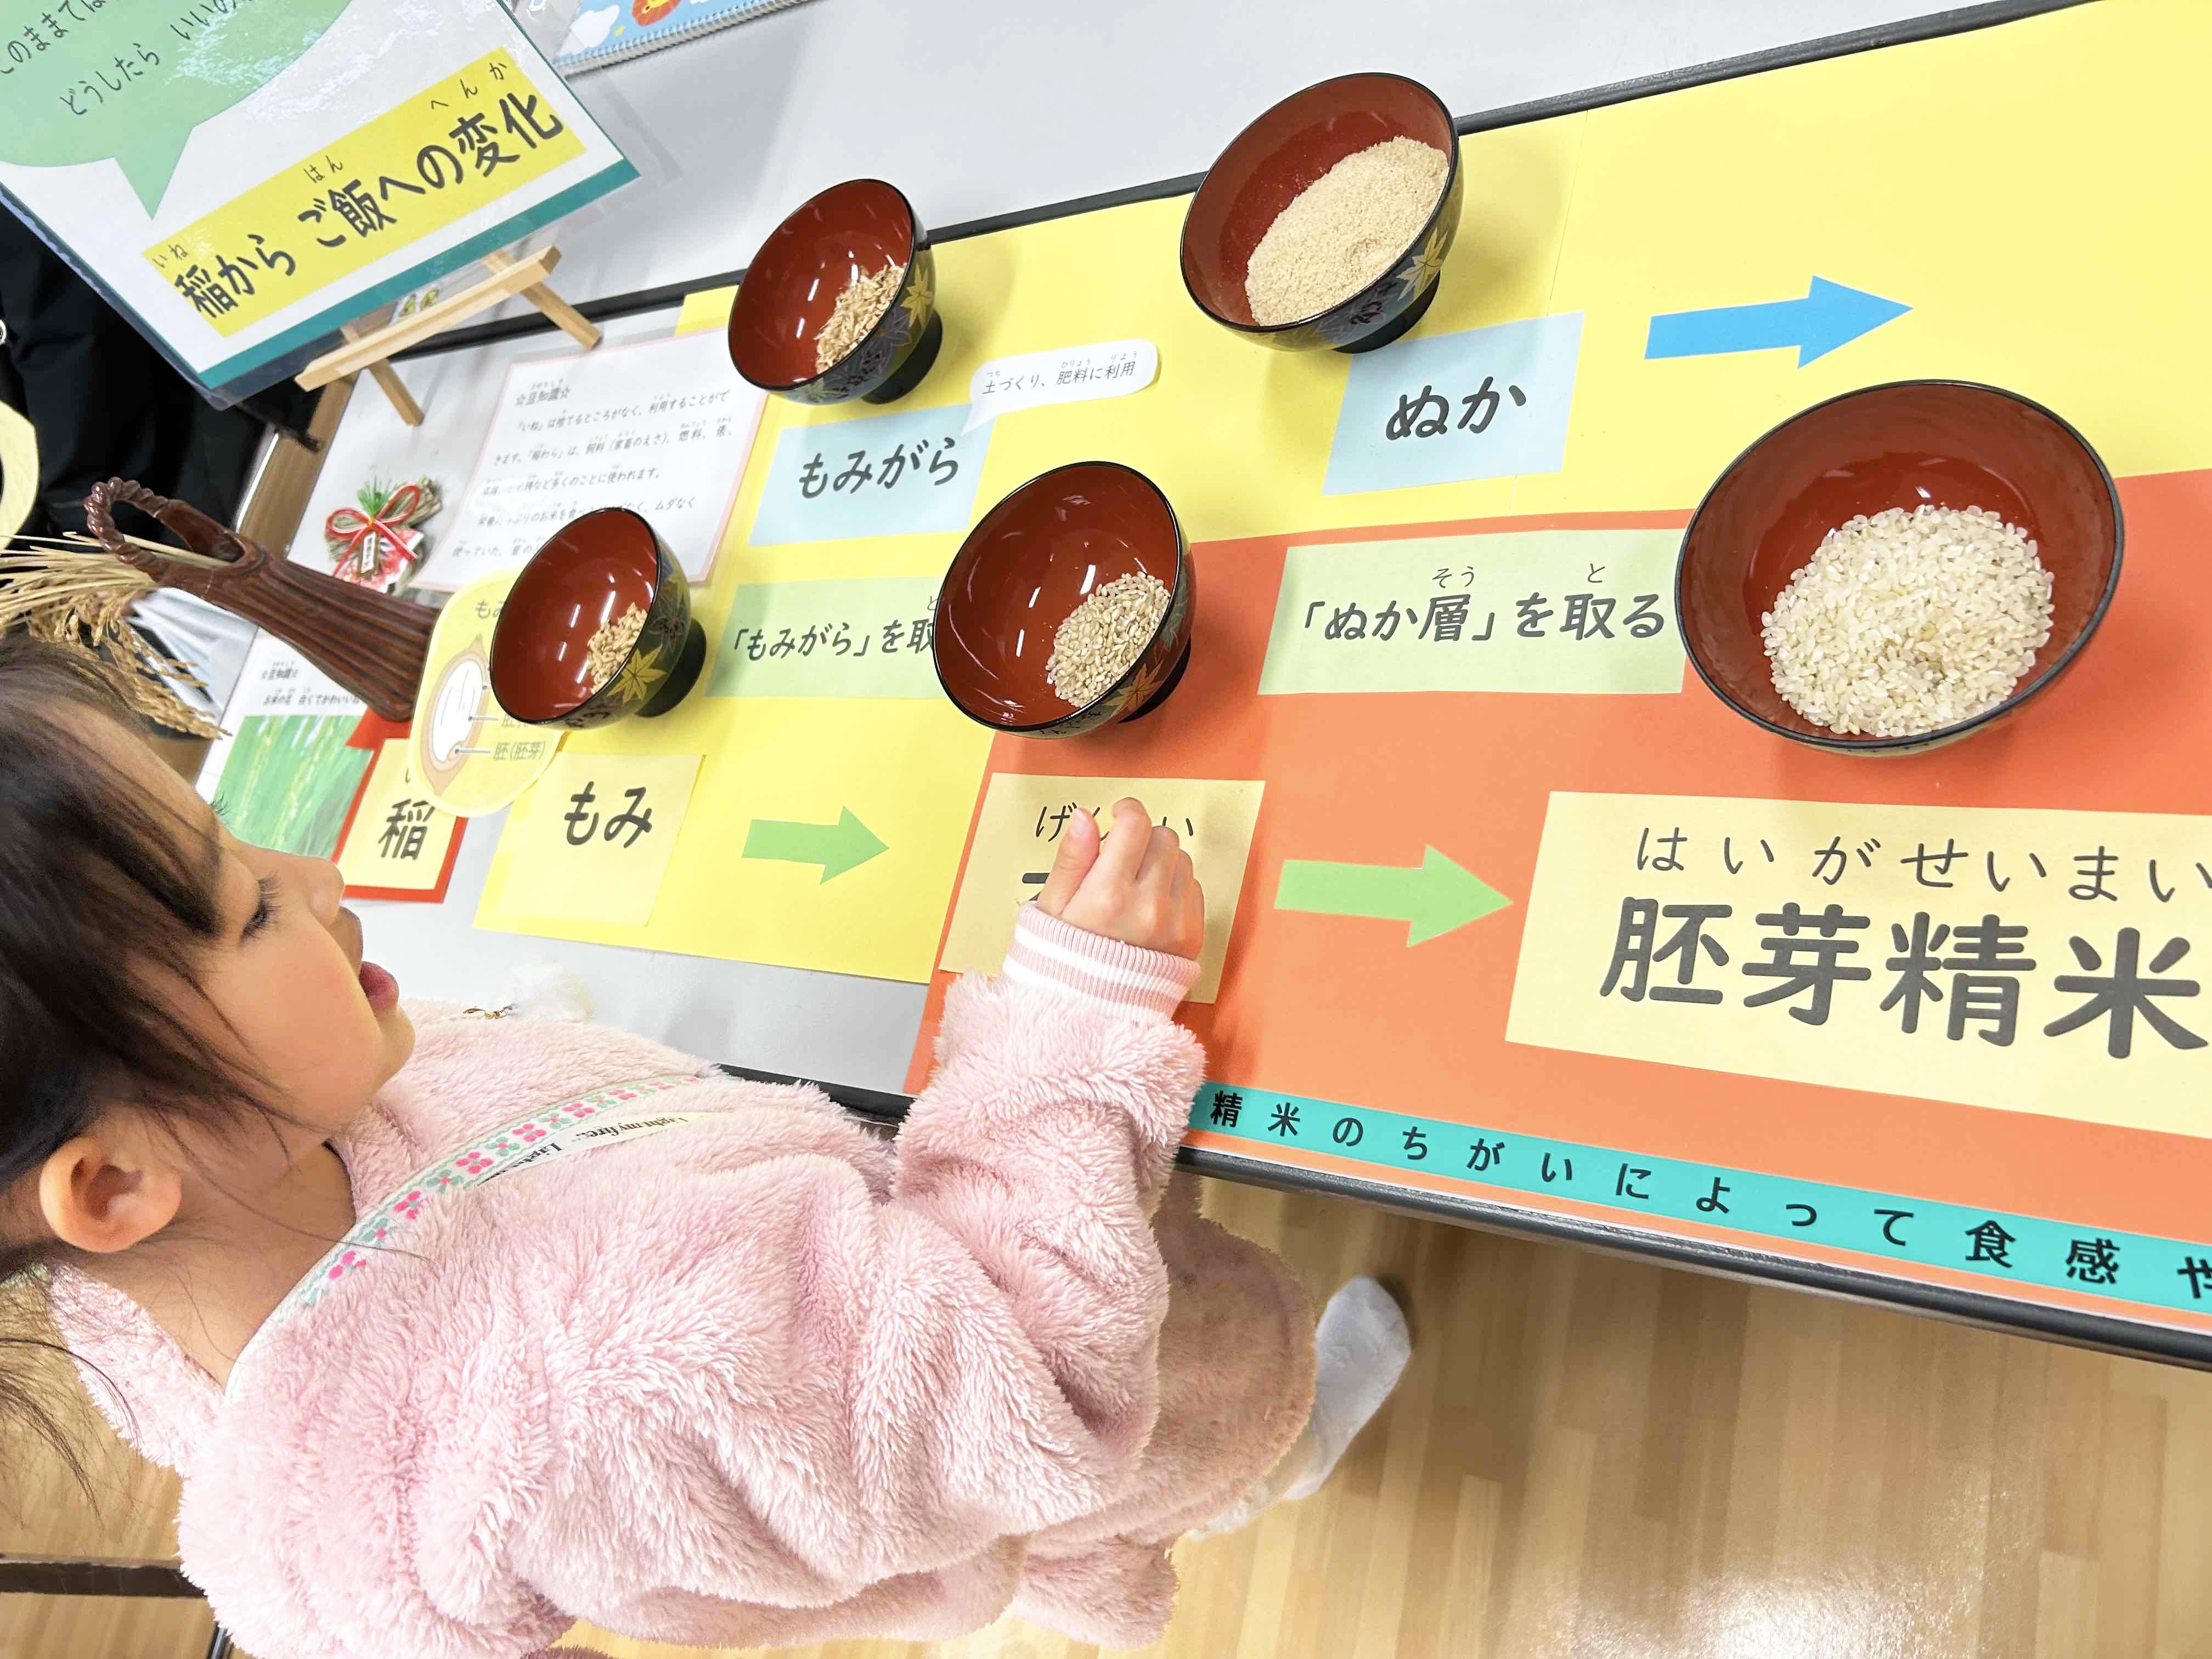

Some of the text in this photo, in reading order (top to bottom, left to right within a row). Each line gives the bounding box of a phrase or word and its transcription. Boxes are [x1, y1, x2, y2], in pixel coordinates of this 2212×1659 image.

[60, 43, 159, 115] どうしたら
[431, 62, 507, 110] へんか
[304, 156, 343, 183] はん
[174, 92, 563, 318] 稲から ご飯への変化
[153, 244, 189, 268] いね
[981, 361, 1136, 394] 土づくり、肥料に利用
[1385, 376, 1526, 440] ぬか
[799, 437, 958, 498] もみがら
[1432, 566, 1474, 588] そう
[1588, 563, 1605, 583] と
[1305, 592, 1664, 641] 「ぬか層」を取る
[378, 798, 436, 860] 稲
[565, 781, 652, 848] もみ
[1036, 802, 1193, 842] げい
[1637, 827, 2212, 903] はいがせいまい
[1599, 897, 2210, 1059] 胚芽精米
